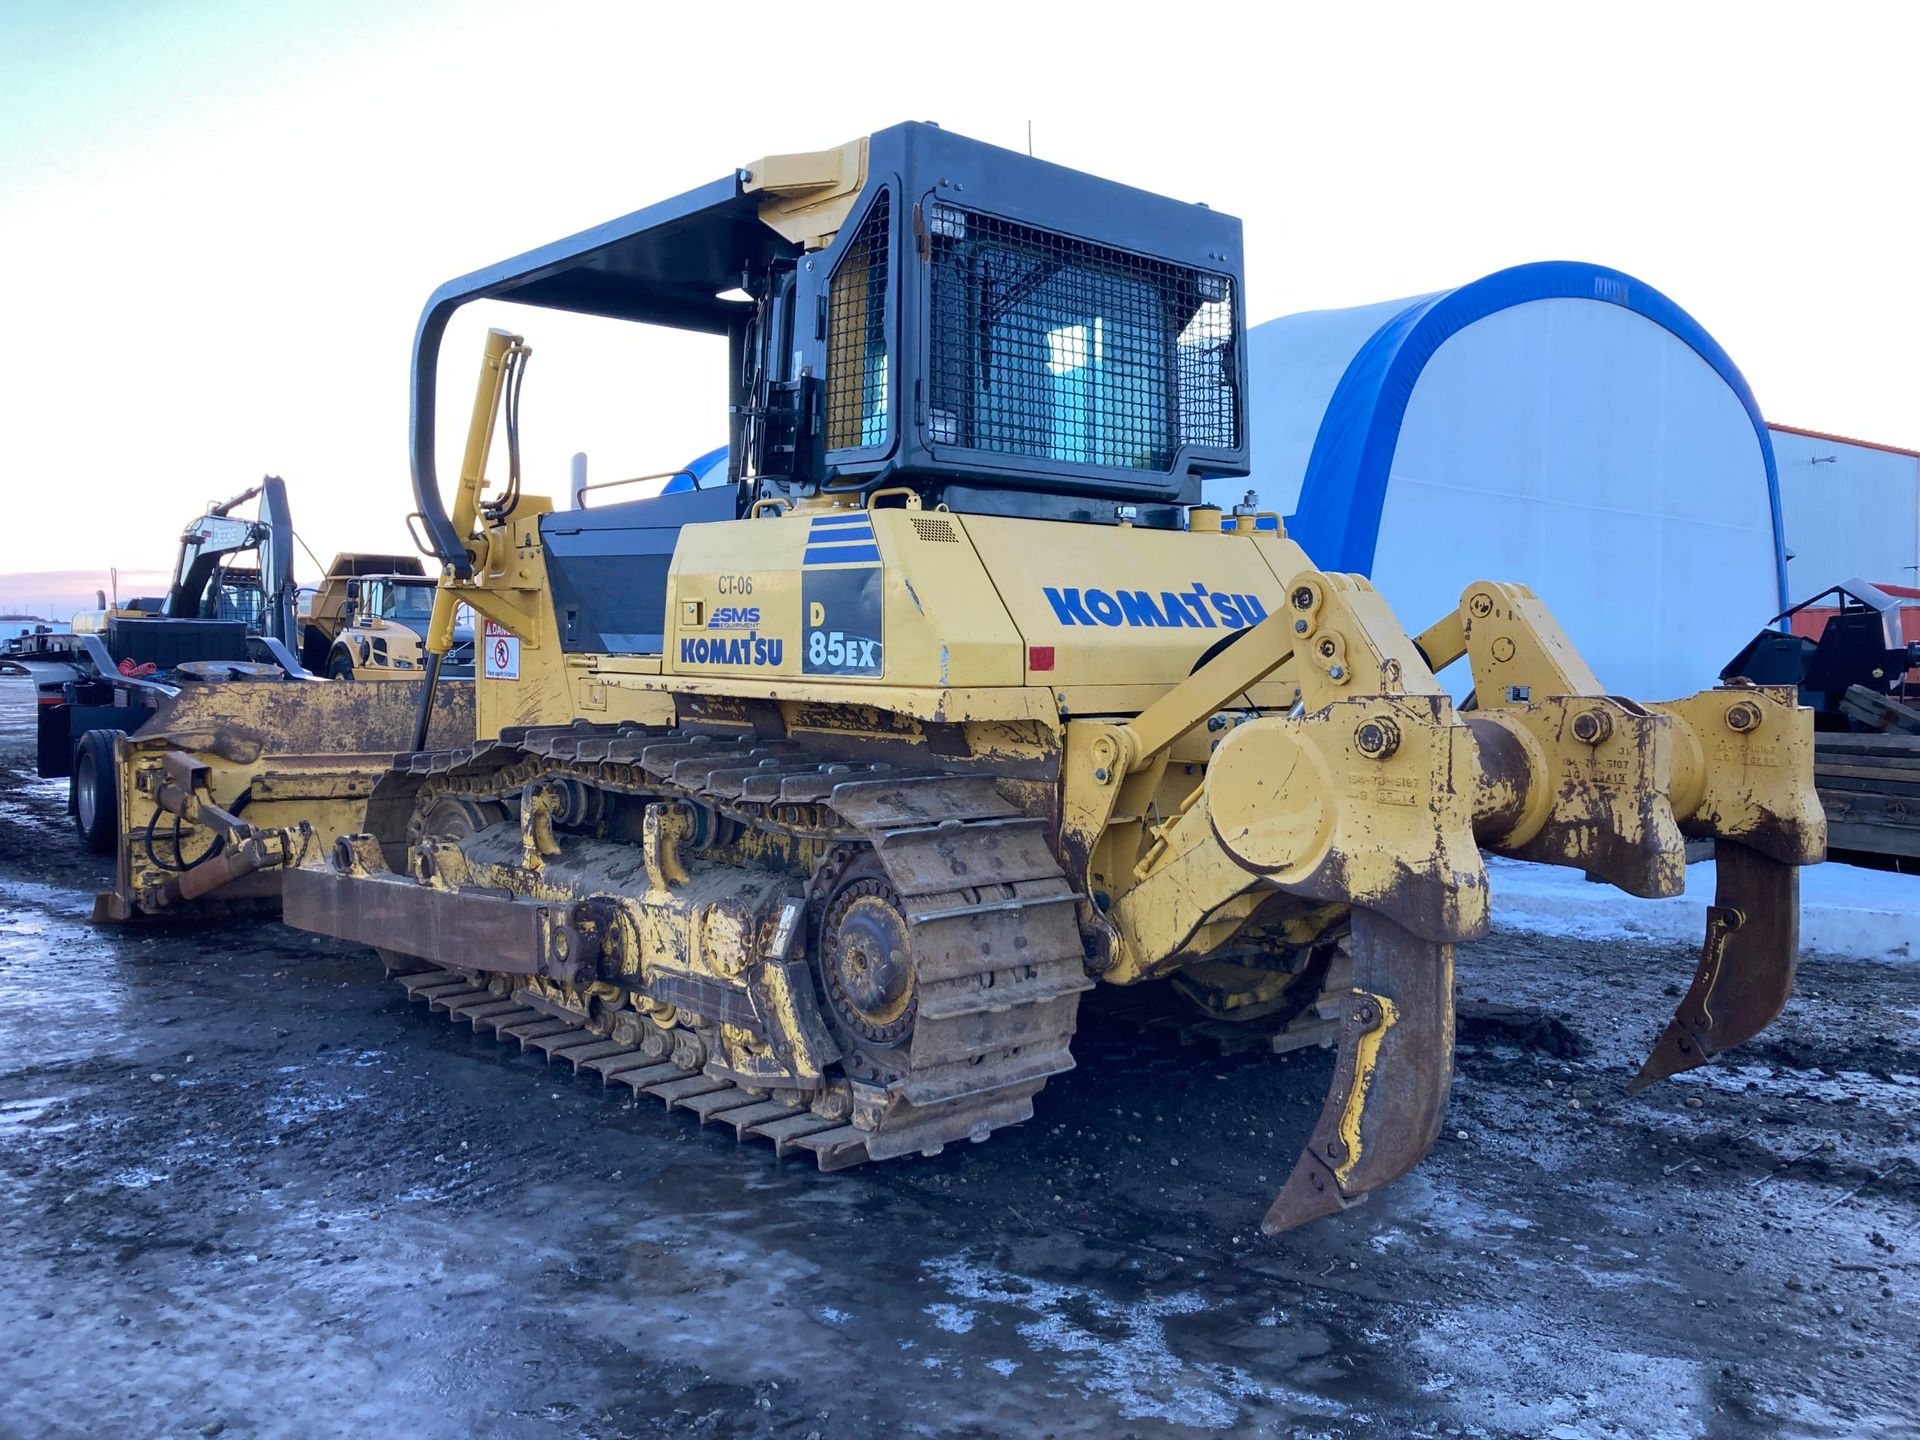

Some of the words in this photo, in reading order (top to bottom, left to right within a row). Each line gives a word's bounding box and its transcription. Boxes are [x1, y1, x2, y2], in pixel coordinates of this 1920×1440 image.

[213, 527, 237, 543] DEERE
[718, 575, 753, 595] CT-06
[720, 607, 760, 623] SMS
[809, 601, 826, 627] D
[1042, 582, 1269, 630] KOMATSU
[681, 631, 783, 667] KOMATSU
[808, 631, 876, 668] 85EX
